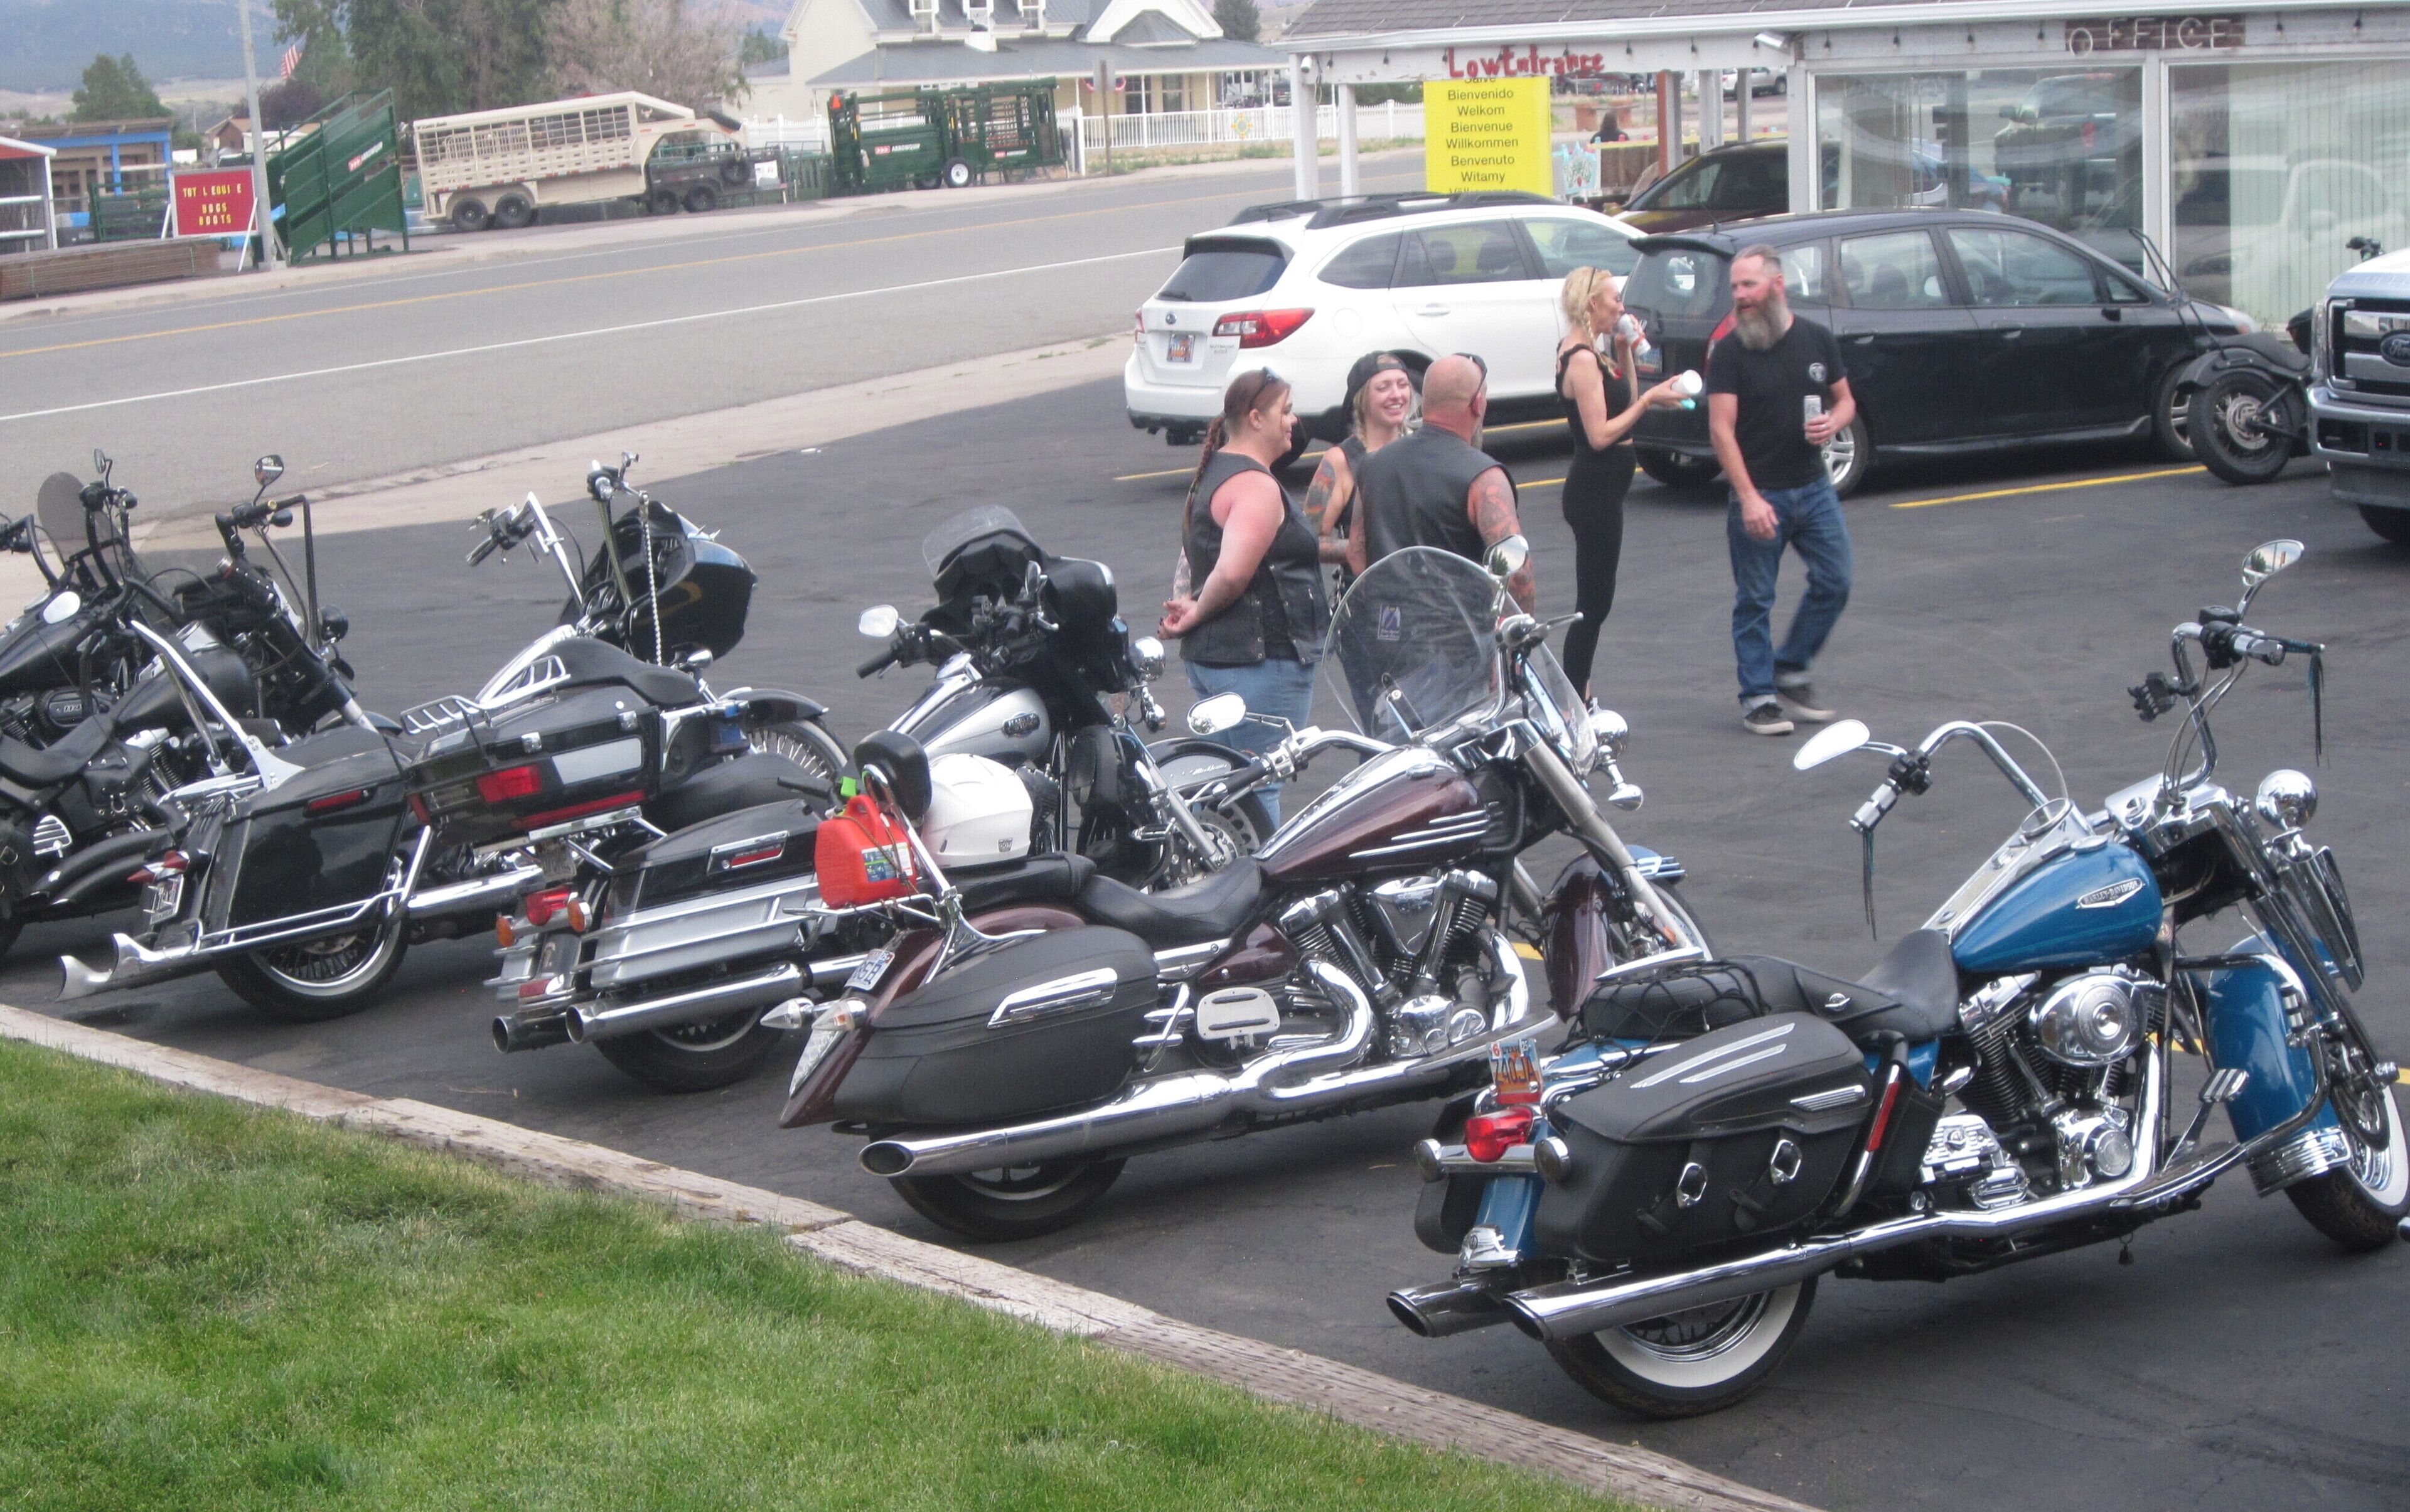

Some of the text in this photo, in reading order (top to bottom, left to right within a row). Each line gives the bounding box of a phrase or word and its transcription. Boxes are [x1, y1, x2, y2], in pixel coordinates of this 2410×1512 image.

[2069, 17, 2233, 58] OFFICE
[1448, 88, 1514, 100] Bienvenido
[1457, 105, 1505, 116] Welkom
[1451, 122, 1513, 132] Bienvenue
[1446, 137, 1519, 149] Willkommen
[1451, 155, 1515, 166] Benvenuto
[1461, 171, 1506, 183] Witamy
[1492, 1043, 1501, 1057] 6
